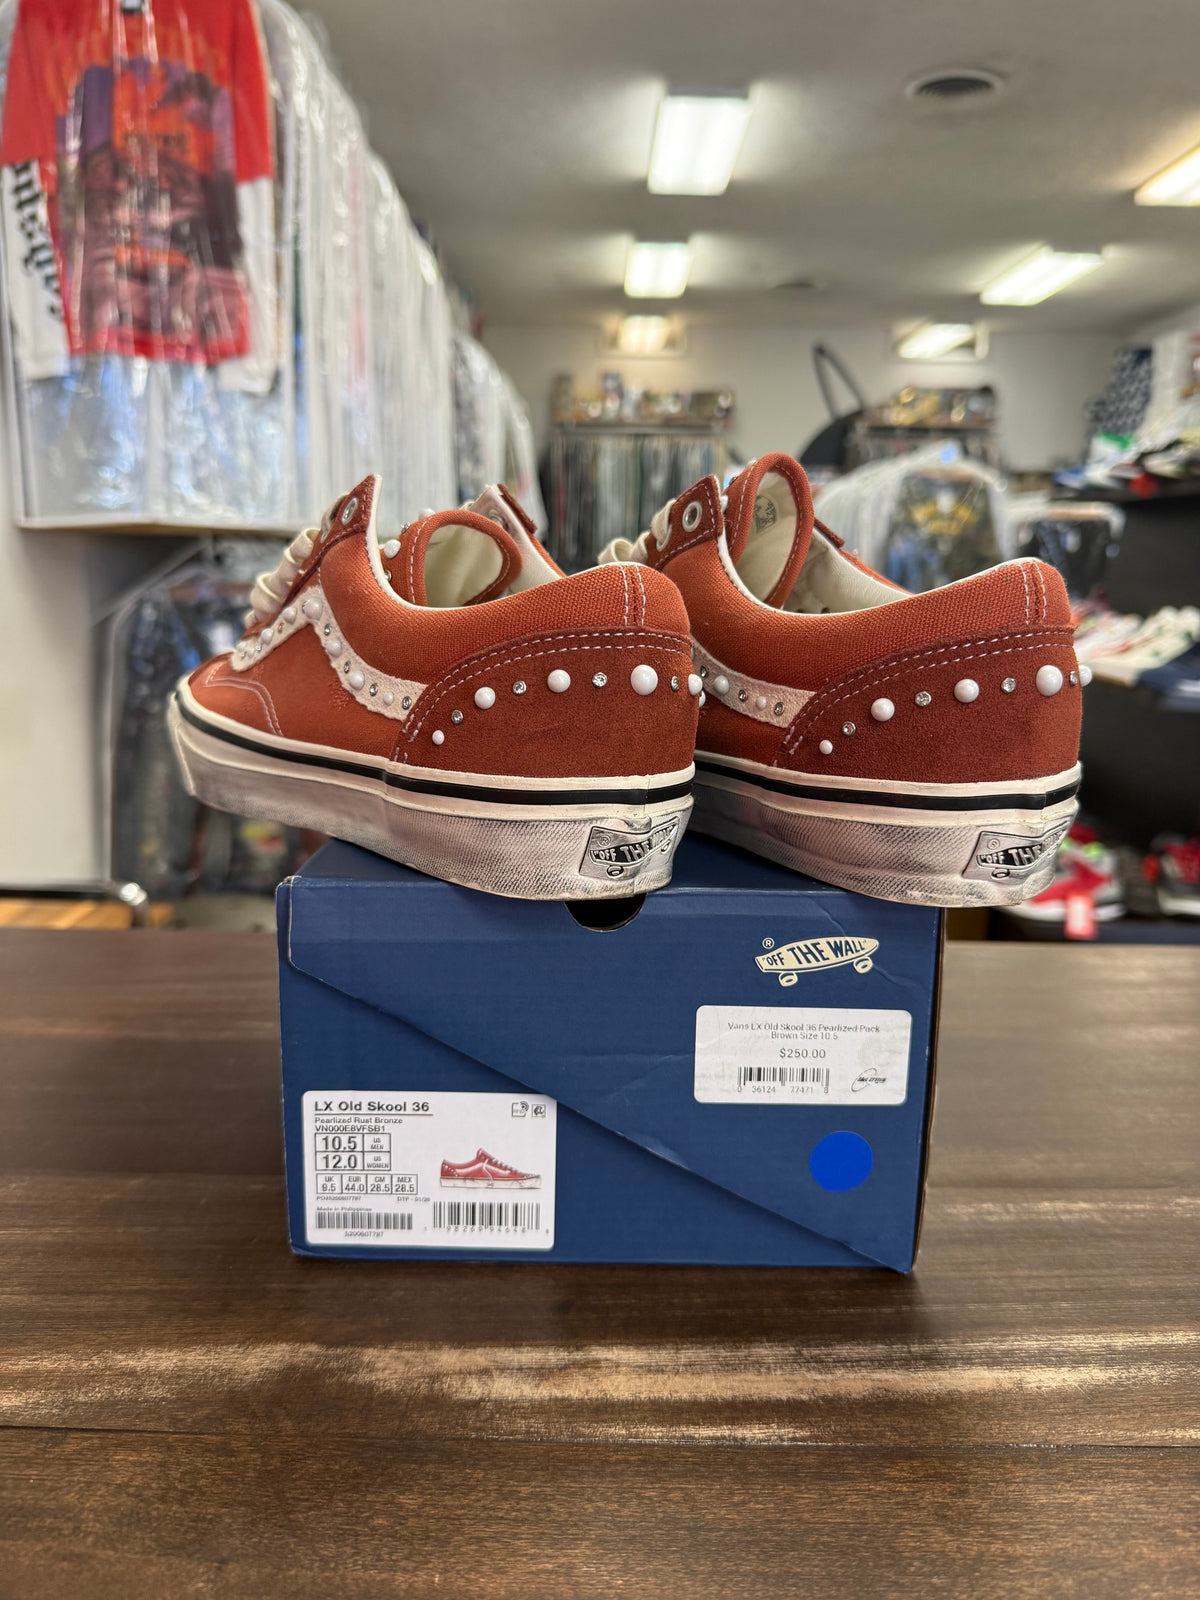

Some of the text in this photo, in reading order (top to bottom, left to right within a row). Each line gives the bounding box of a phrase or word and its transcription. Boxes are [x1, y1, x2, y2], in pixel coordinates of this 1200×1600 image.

[786, 941, 830, 965] THE
[727, 1022, 880, 1033] Vans LX Old Skool 36 Pearlized Pack
[771, 1031, 798, 1040] Brown
[800, 1032, 818, 1040] Size
[779, 1047, 827, 1060] $250.00
[314, 1100, 430, 1113] LX Old Skool 36
[314, 1116, 404, 1125] Pearlized Rust Bronze
[321, 1135, 358, 1151] 10.5
[321, 1154, 359, 1170] 12.0
[324, 1175, 335, 1183] UK
[321, 1183, 416, 1193] 9.5 44.0 28.5 28.5
